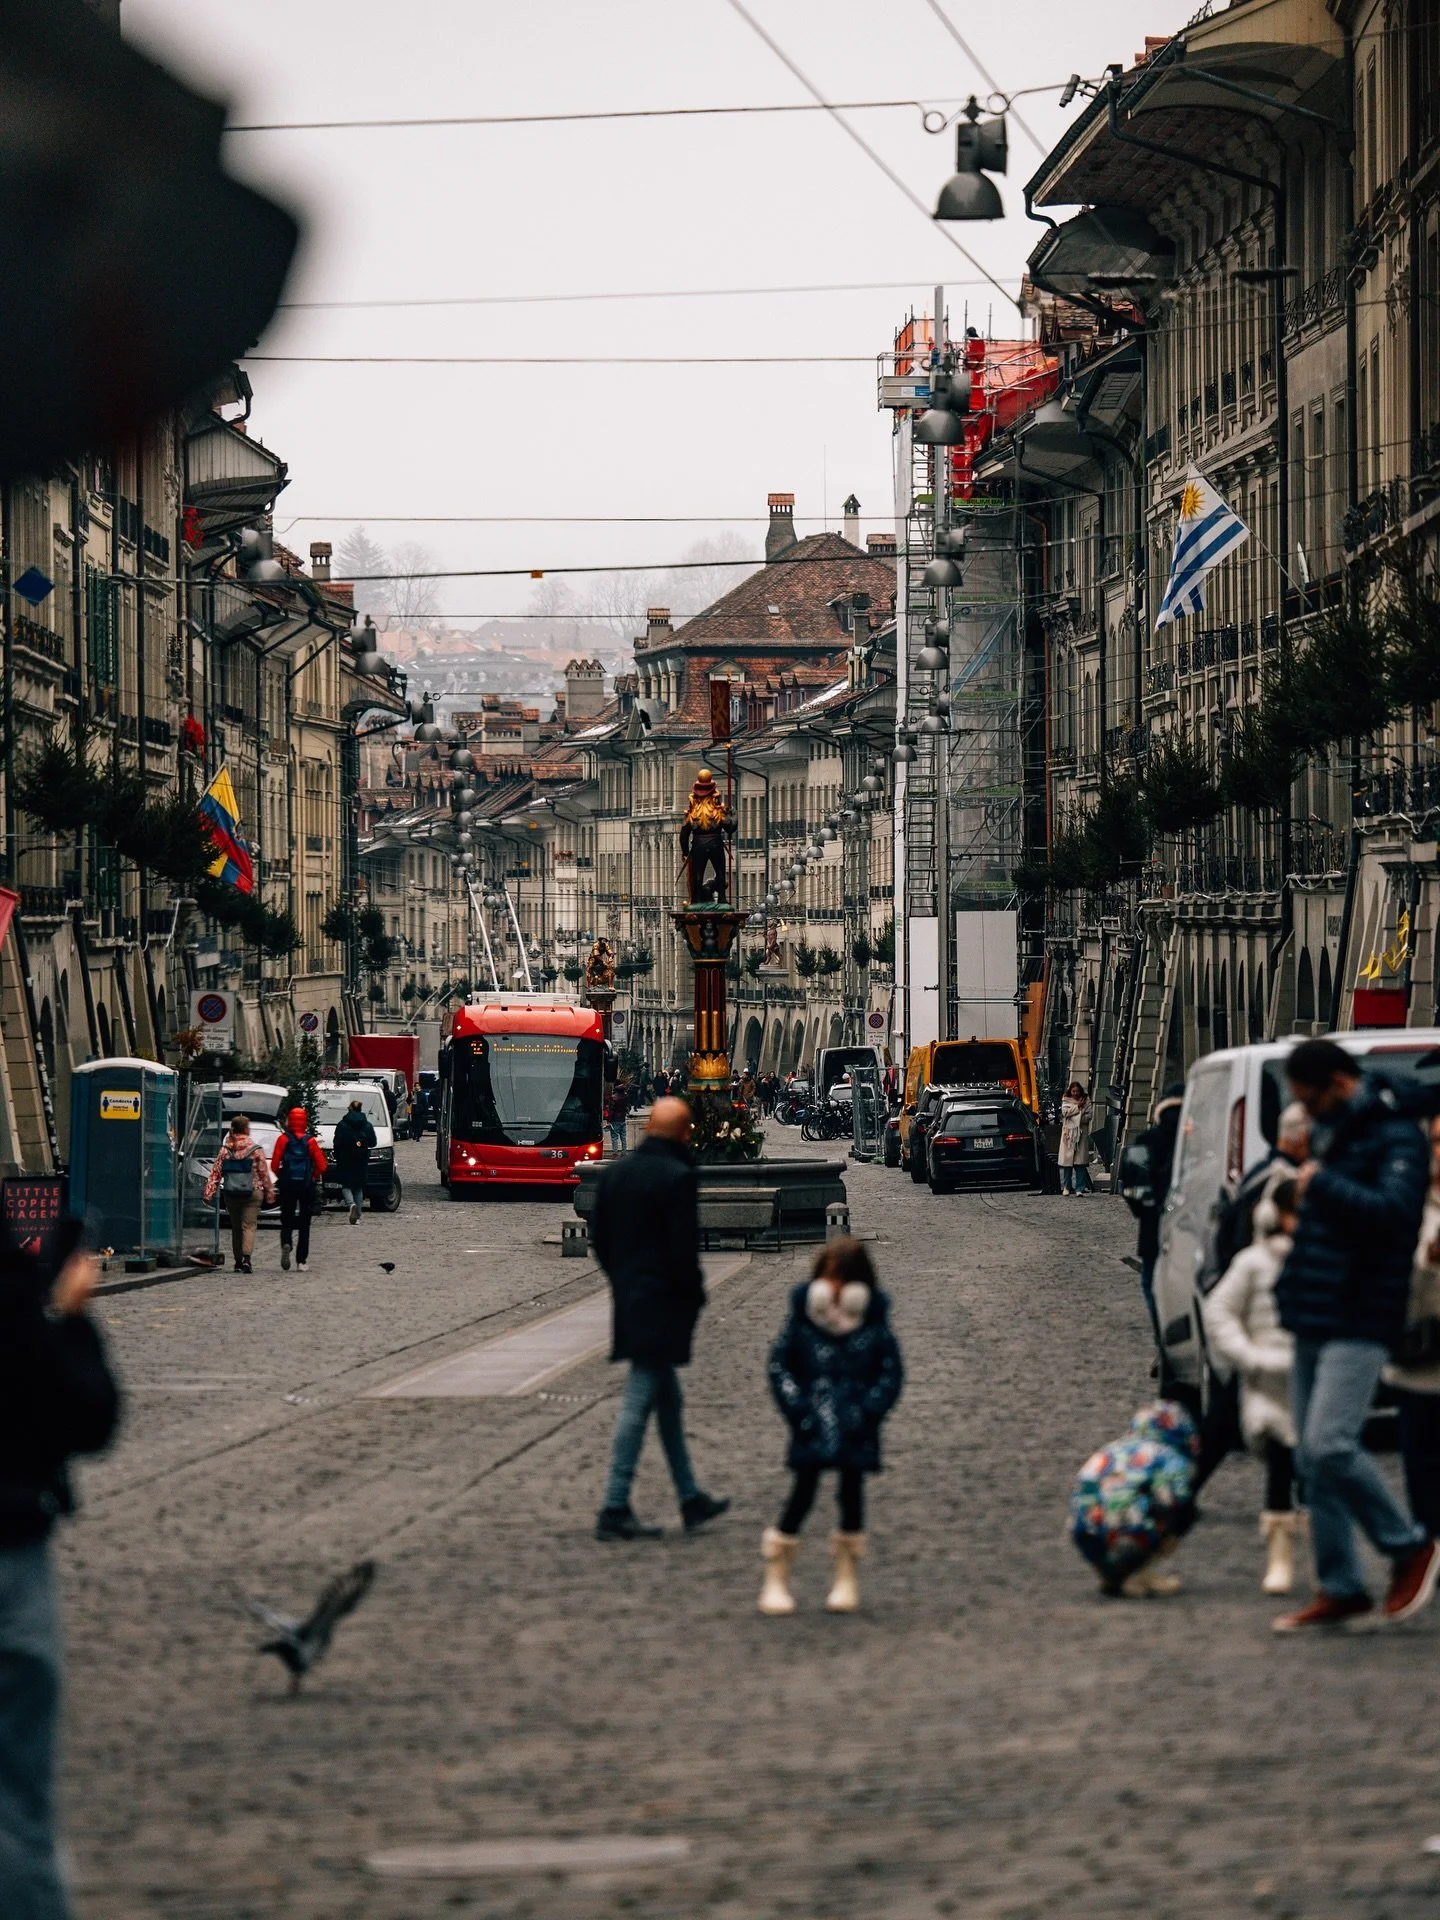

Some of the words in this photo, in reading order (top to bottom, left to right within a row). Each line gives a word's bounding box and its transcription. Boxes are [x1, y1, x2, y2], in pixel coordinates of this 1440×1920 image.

[551, 1150, 563, 1159] 36
[7, 1187, 60, 1197] LITTLE
[7, 1199, 59, 1208] COPEN
[7, 1210, 59, 1219] HAGEN
